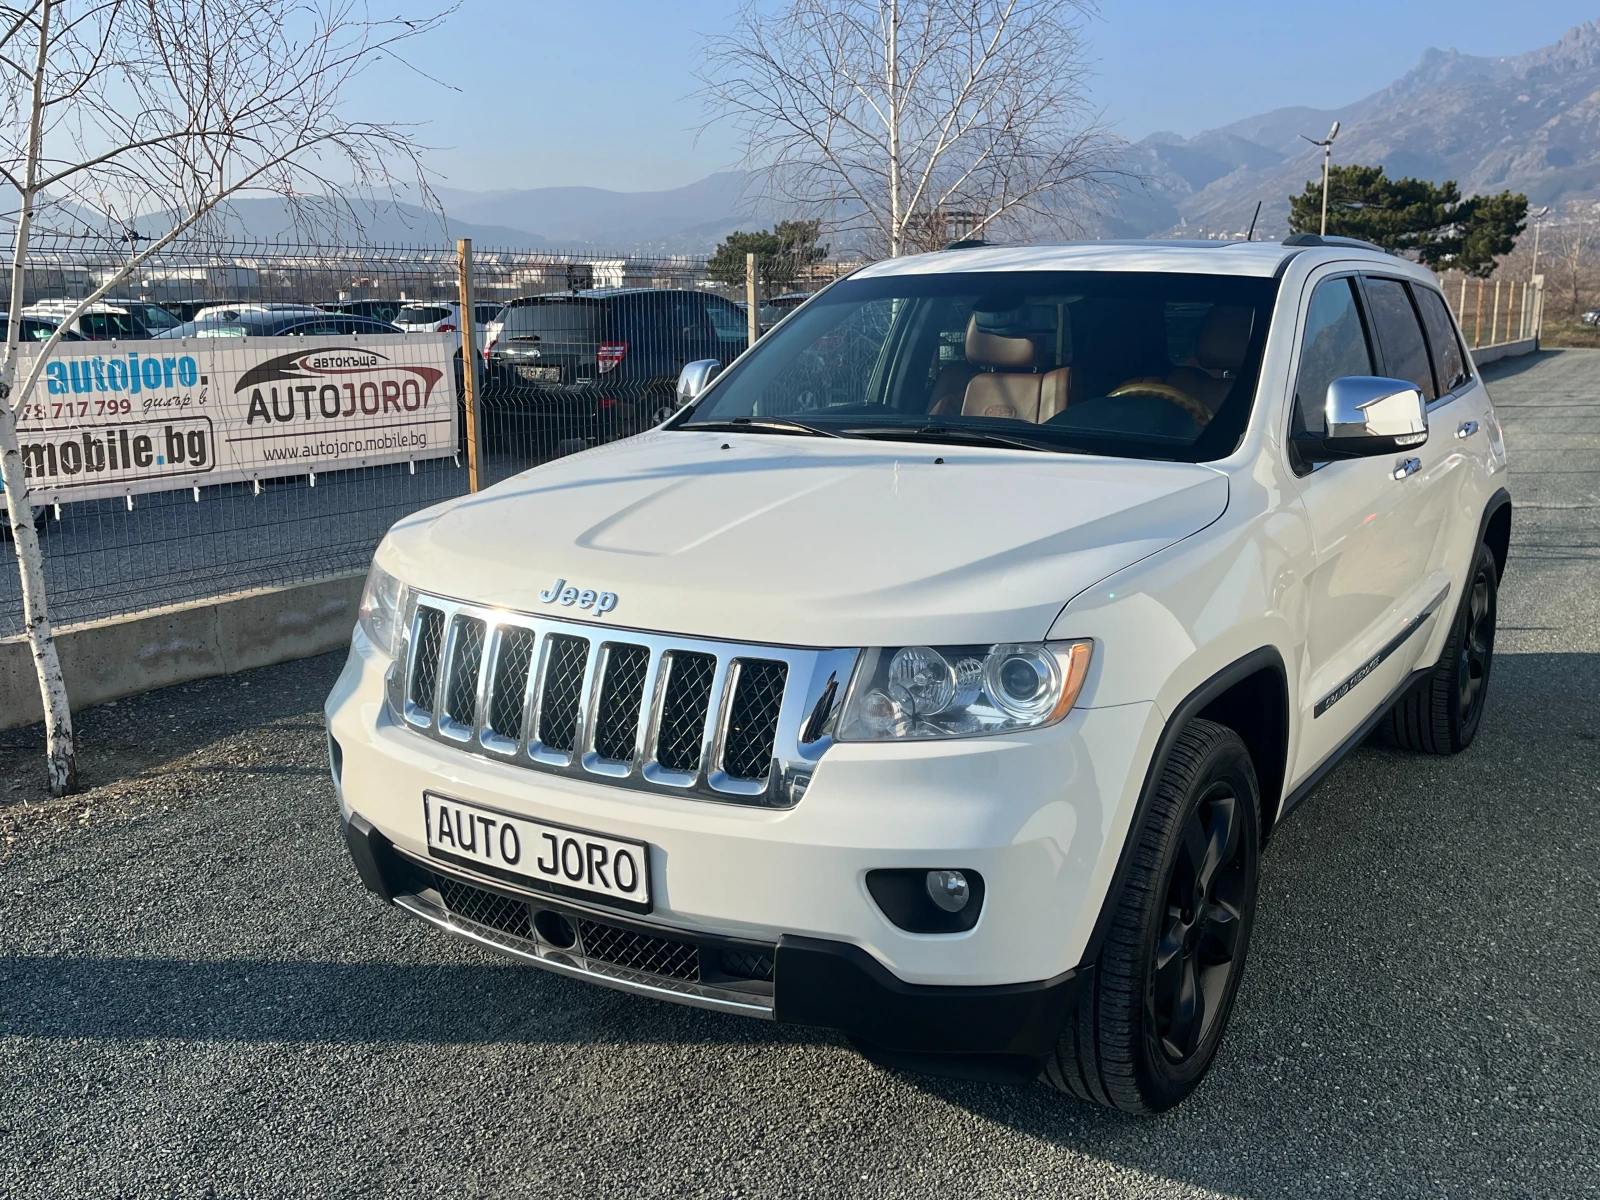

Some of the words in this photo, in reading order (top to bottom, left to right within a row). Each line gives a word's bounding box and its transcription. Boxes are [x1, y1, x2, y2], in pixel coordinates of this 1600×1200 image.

[313, 355, 377, 368] автокъща
[10, 403, 47, 421] 78
[51, 401, 89, 420] 717
[94, 399, 132, 417] 799
[142, 393, 192, 415] дилър
[246, 379, 421, 425] AUTOJORO
[21, 425, 208, 479] mobile.bg
[263, 430, 427, 461] www.autojoro.mobile.bg
[540, 578, 619, 617] Jeep
[438, 805, 521, 866] AUTO
[537, 832, 637, 893] JORO
